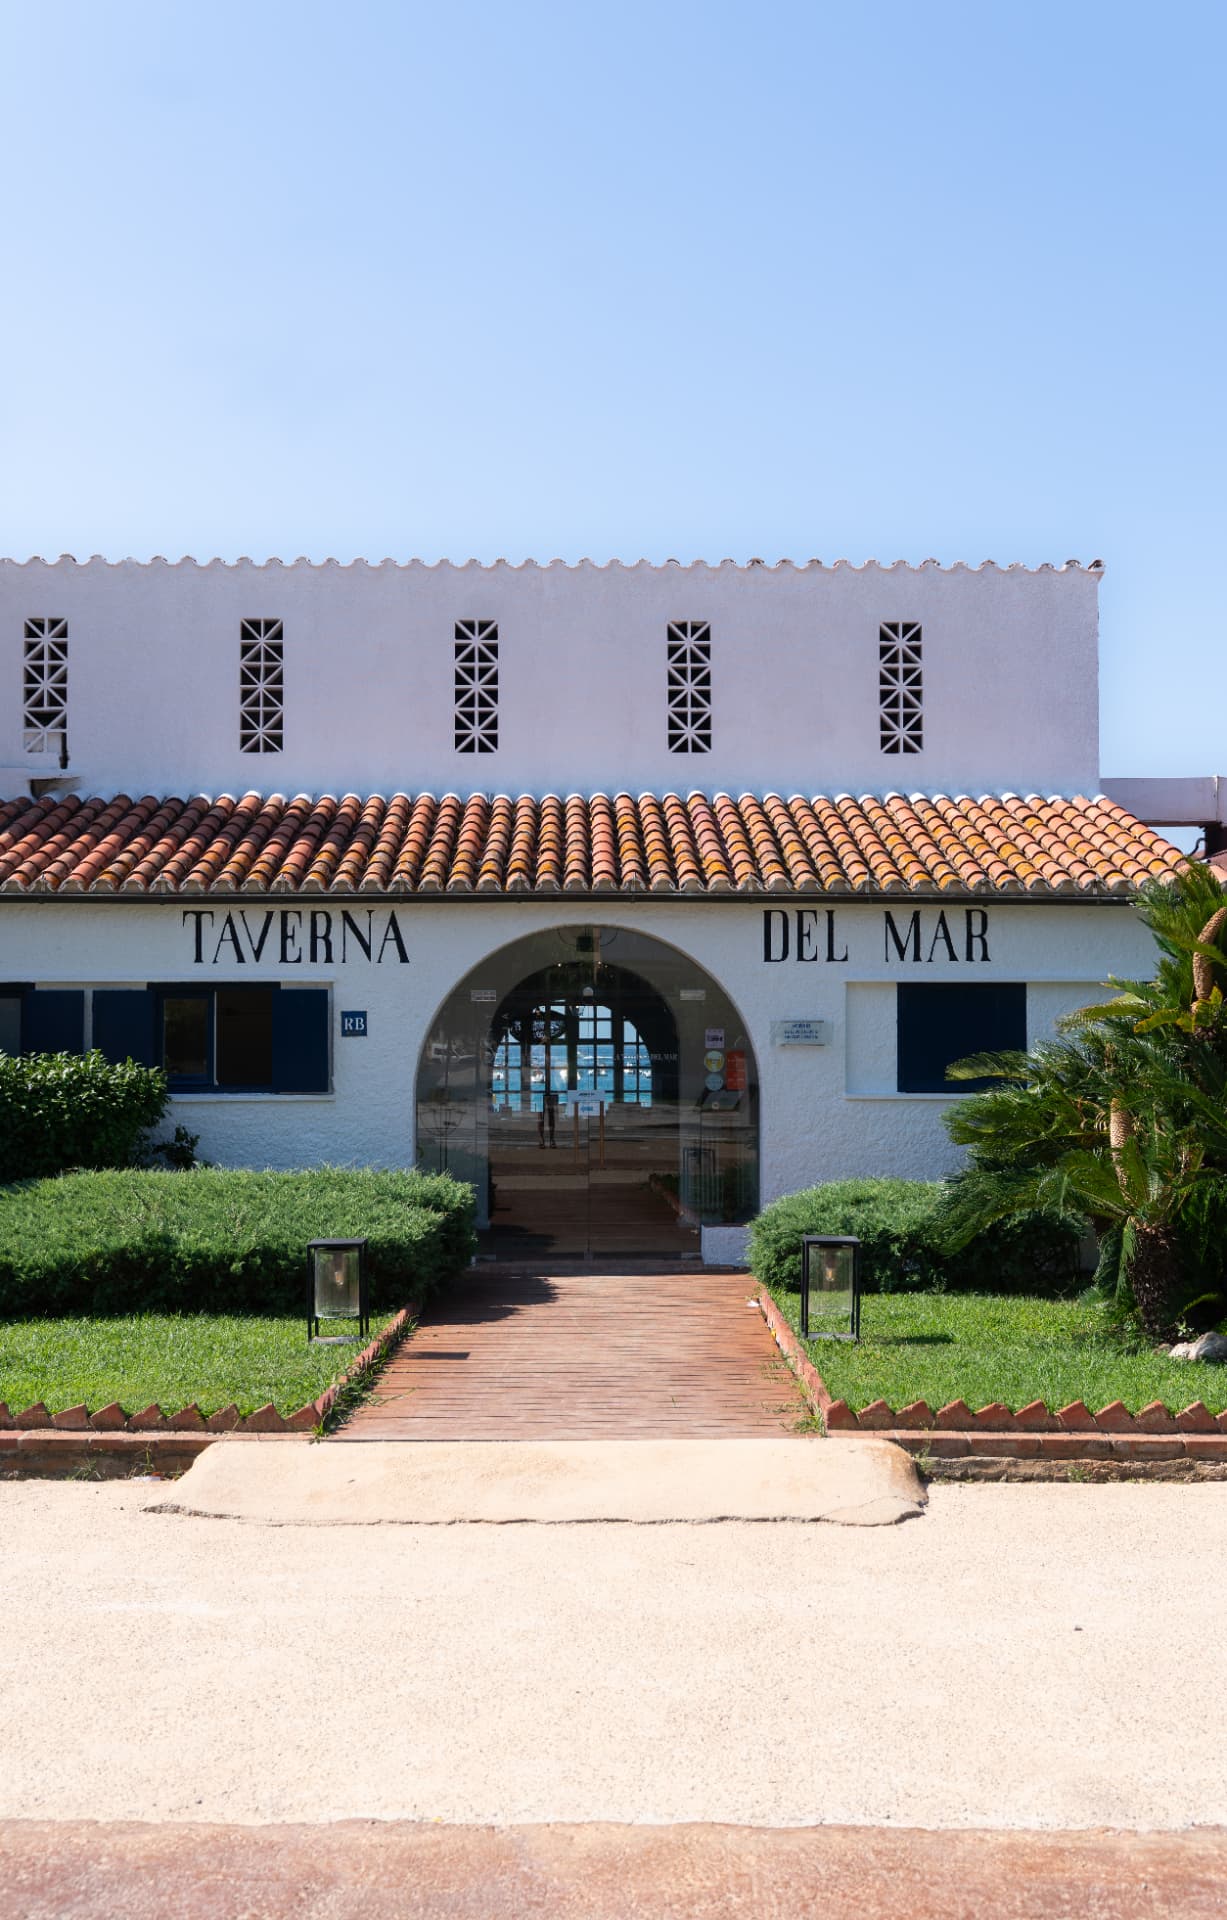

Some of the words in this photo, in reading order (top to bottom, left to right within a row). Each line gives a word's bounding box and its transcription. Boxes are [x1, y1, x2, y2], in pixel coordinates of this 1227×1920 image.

[182, 909, 410, 963] TAVERNA
[763, 909, 848, 962] DEL
[883, 909, 992, 962] MAR
[345, 1017, 365, 1030] RB
